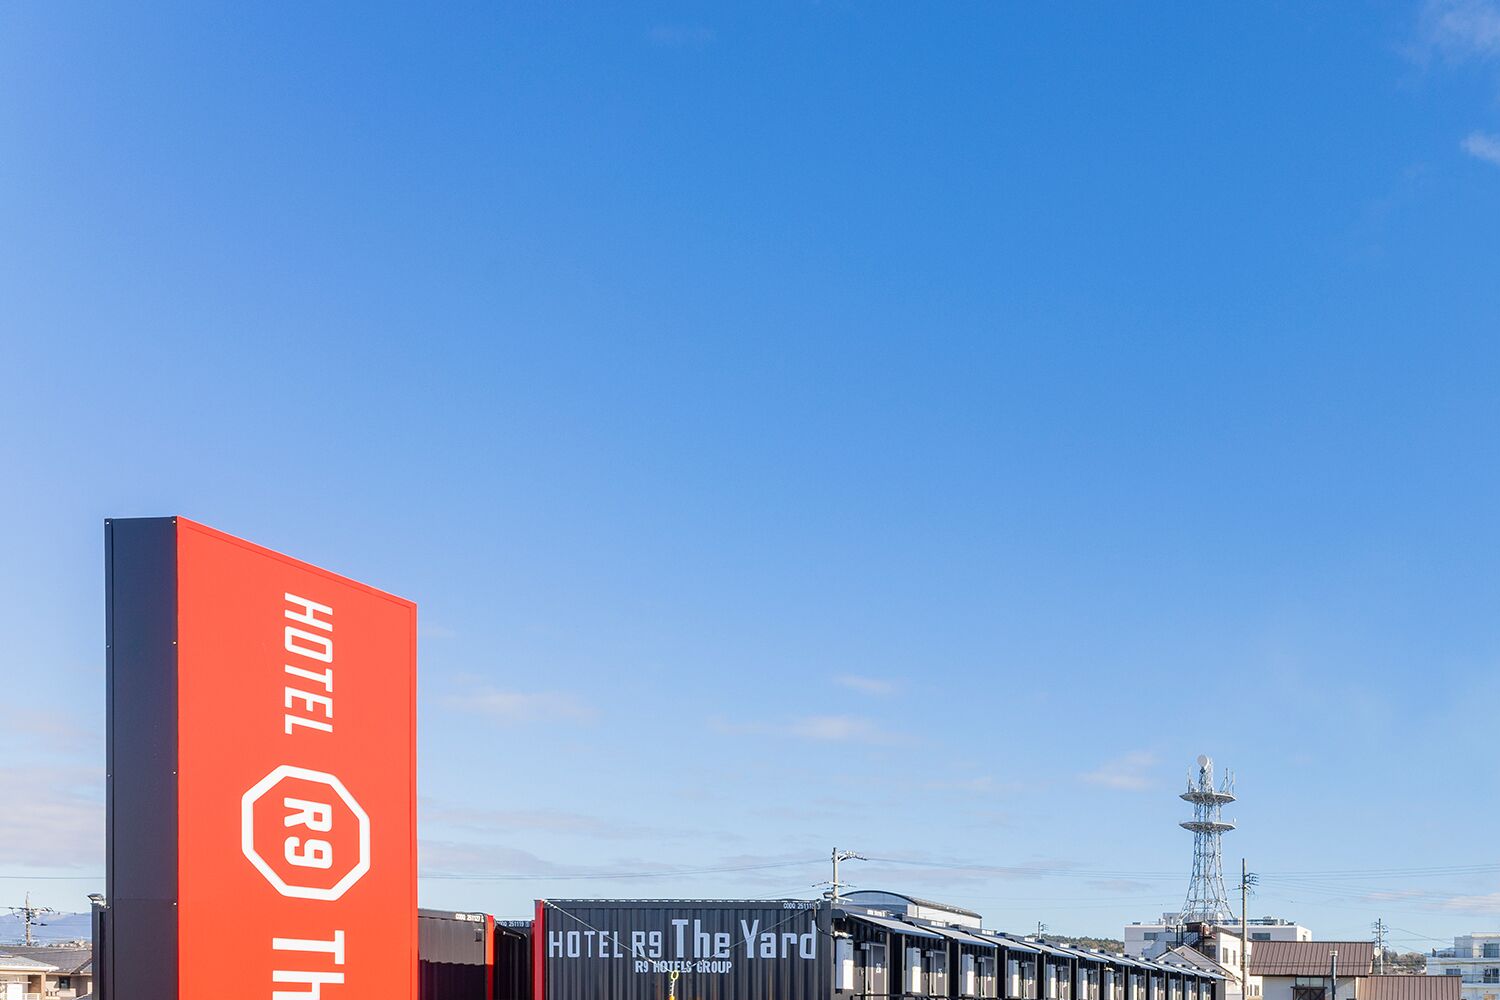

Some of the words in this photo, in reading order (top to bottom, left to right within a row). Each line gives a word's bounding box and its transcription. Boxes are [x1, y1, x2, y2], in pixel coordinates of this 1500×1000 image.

[284, 592, 334, 735] HOTEL
[283, 797, 334, 870] R9
[549, 930, 623, 958] HOTEL
[631, 931, 662, 958] R9
[671, 919, 730, 958] The
[741, 919, 816, 959] Yard
[635, 961, 649, 973] R9
[653, 961, 692, 973] HOTELS
[696, 961, 732, 973] GROUP
